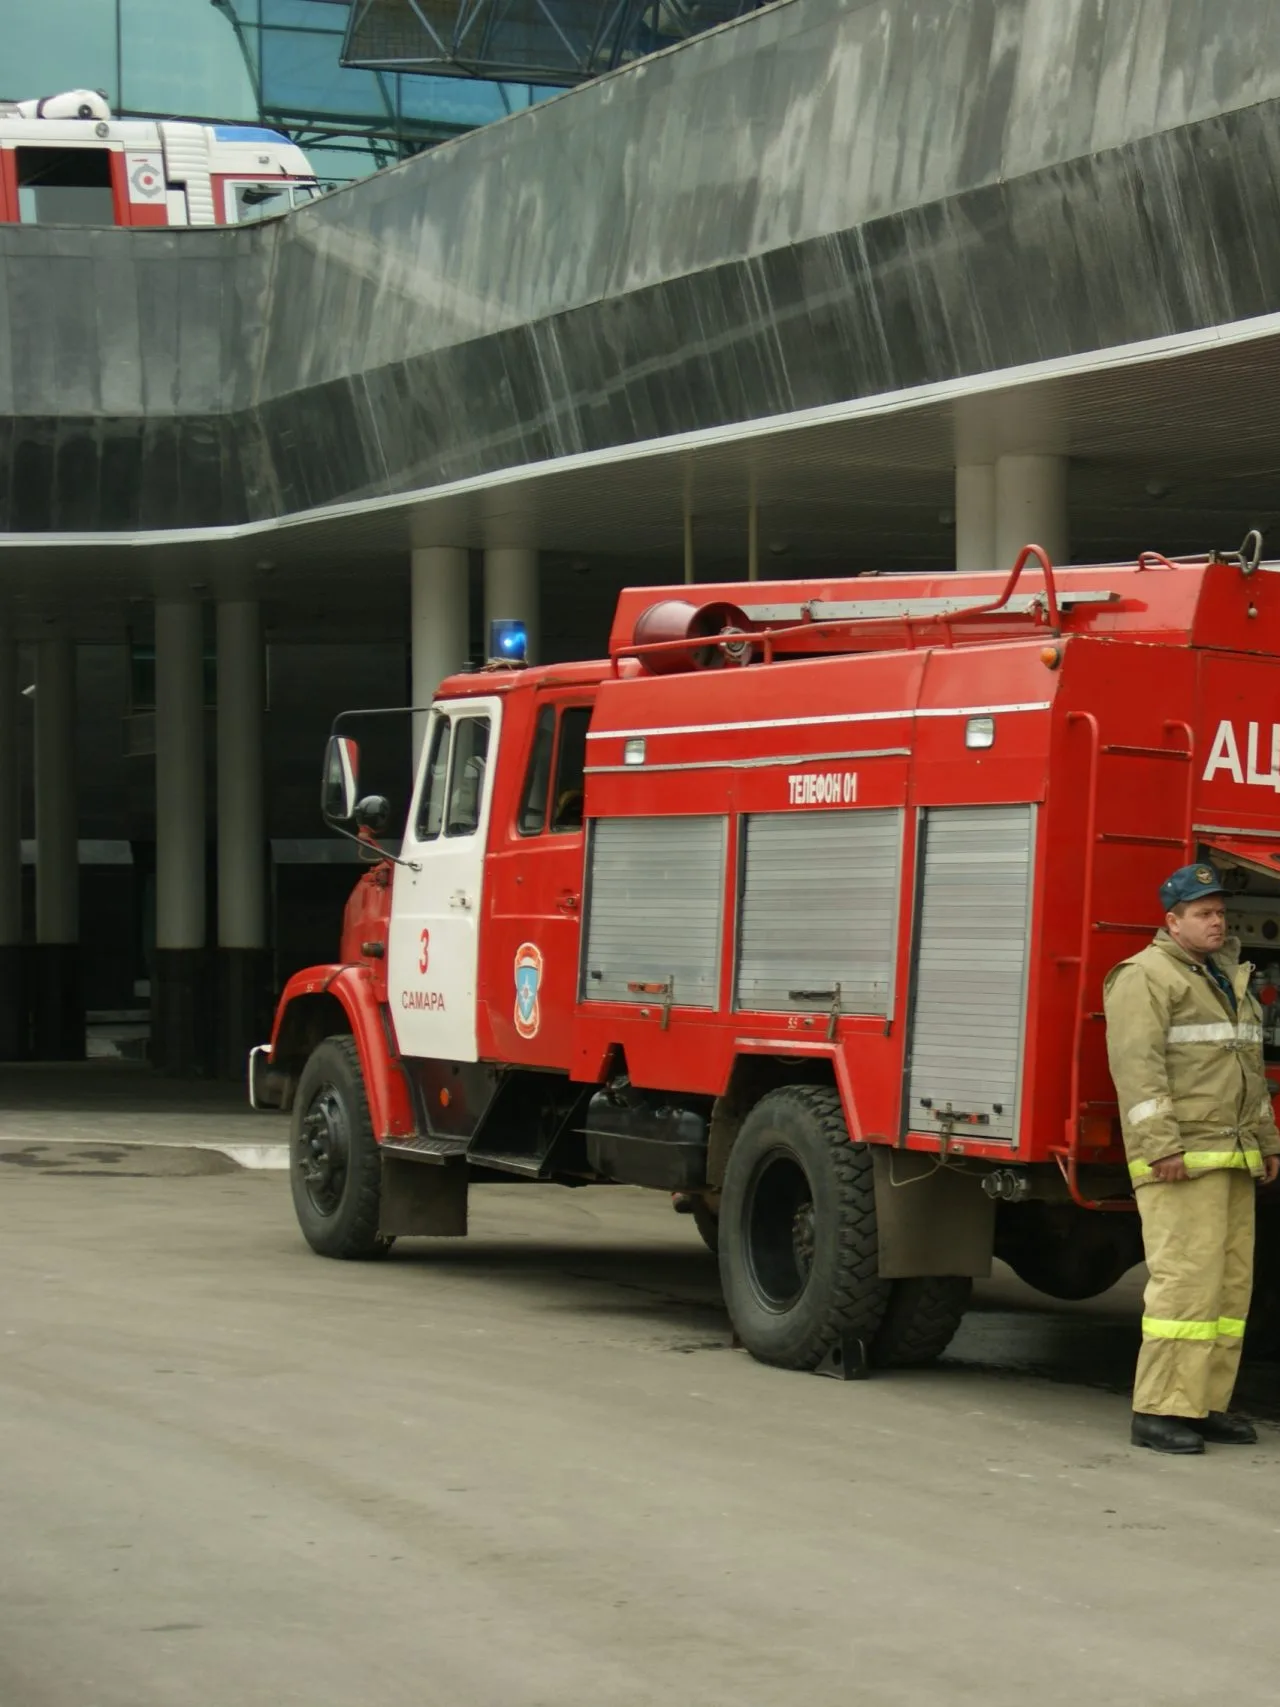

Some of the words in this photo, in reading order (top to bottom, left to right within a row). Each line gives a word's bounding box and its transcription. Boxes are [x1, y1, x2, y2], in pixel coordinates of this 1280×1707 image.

[788, 773, 842, 804] ТЕЛЕФОН
[843, 772, 857, 803] 01
[419, 928, 430, 975] 3
[401, 991, 446, 1011] САМАРА
